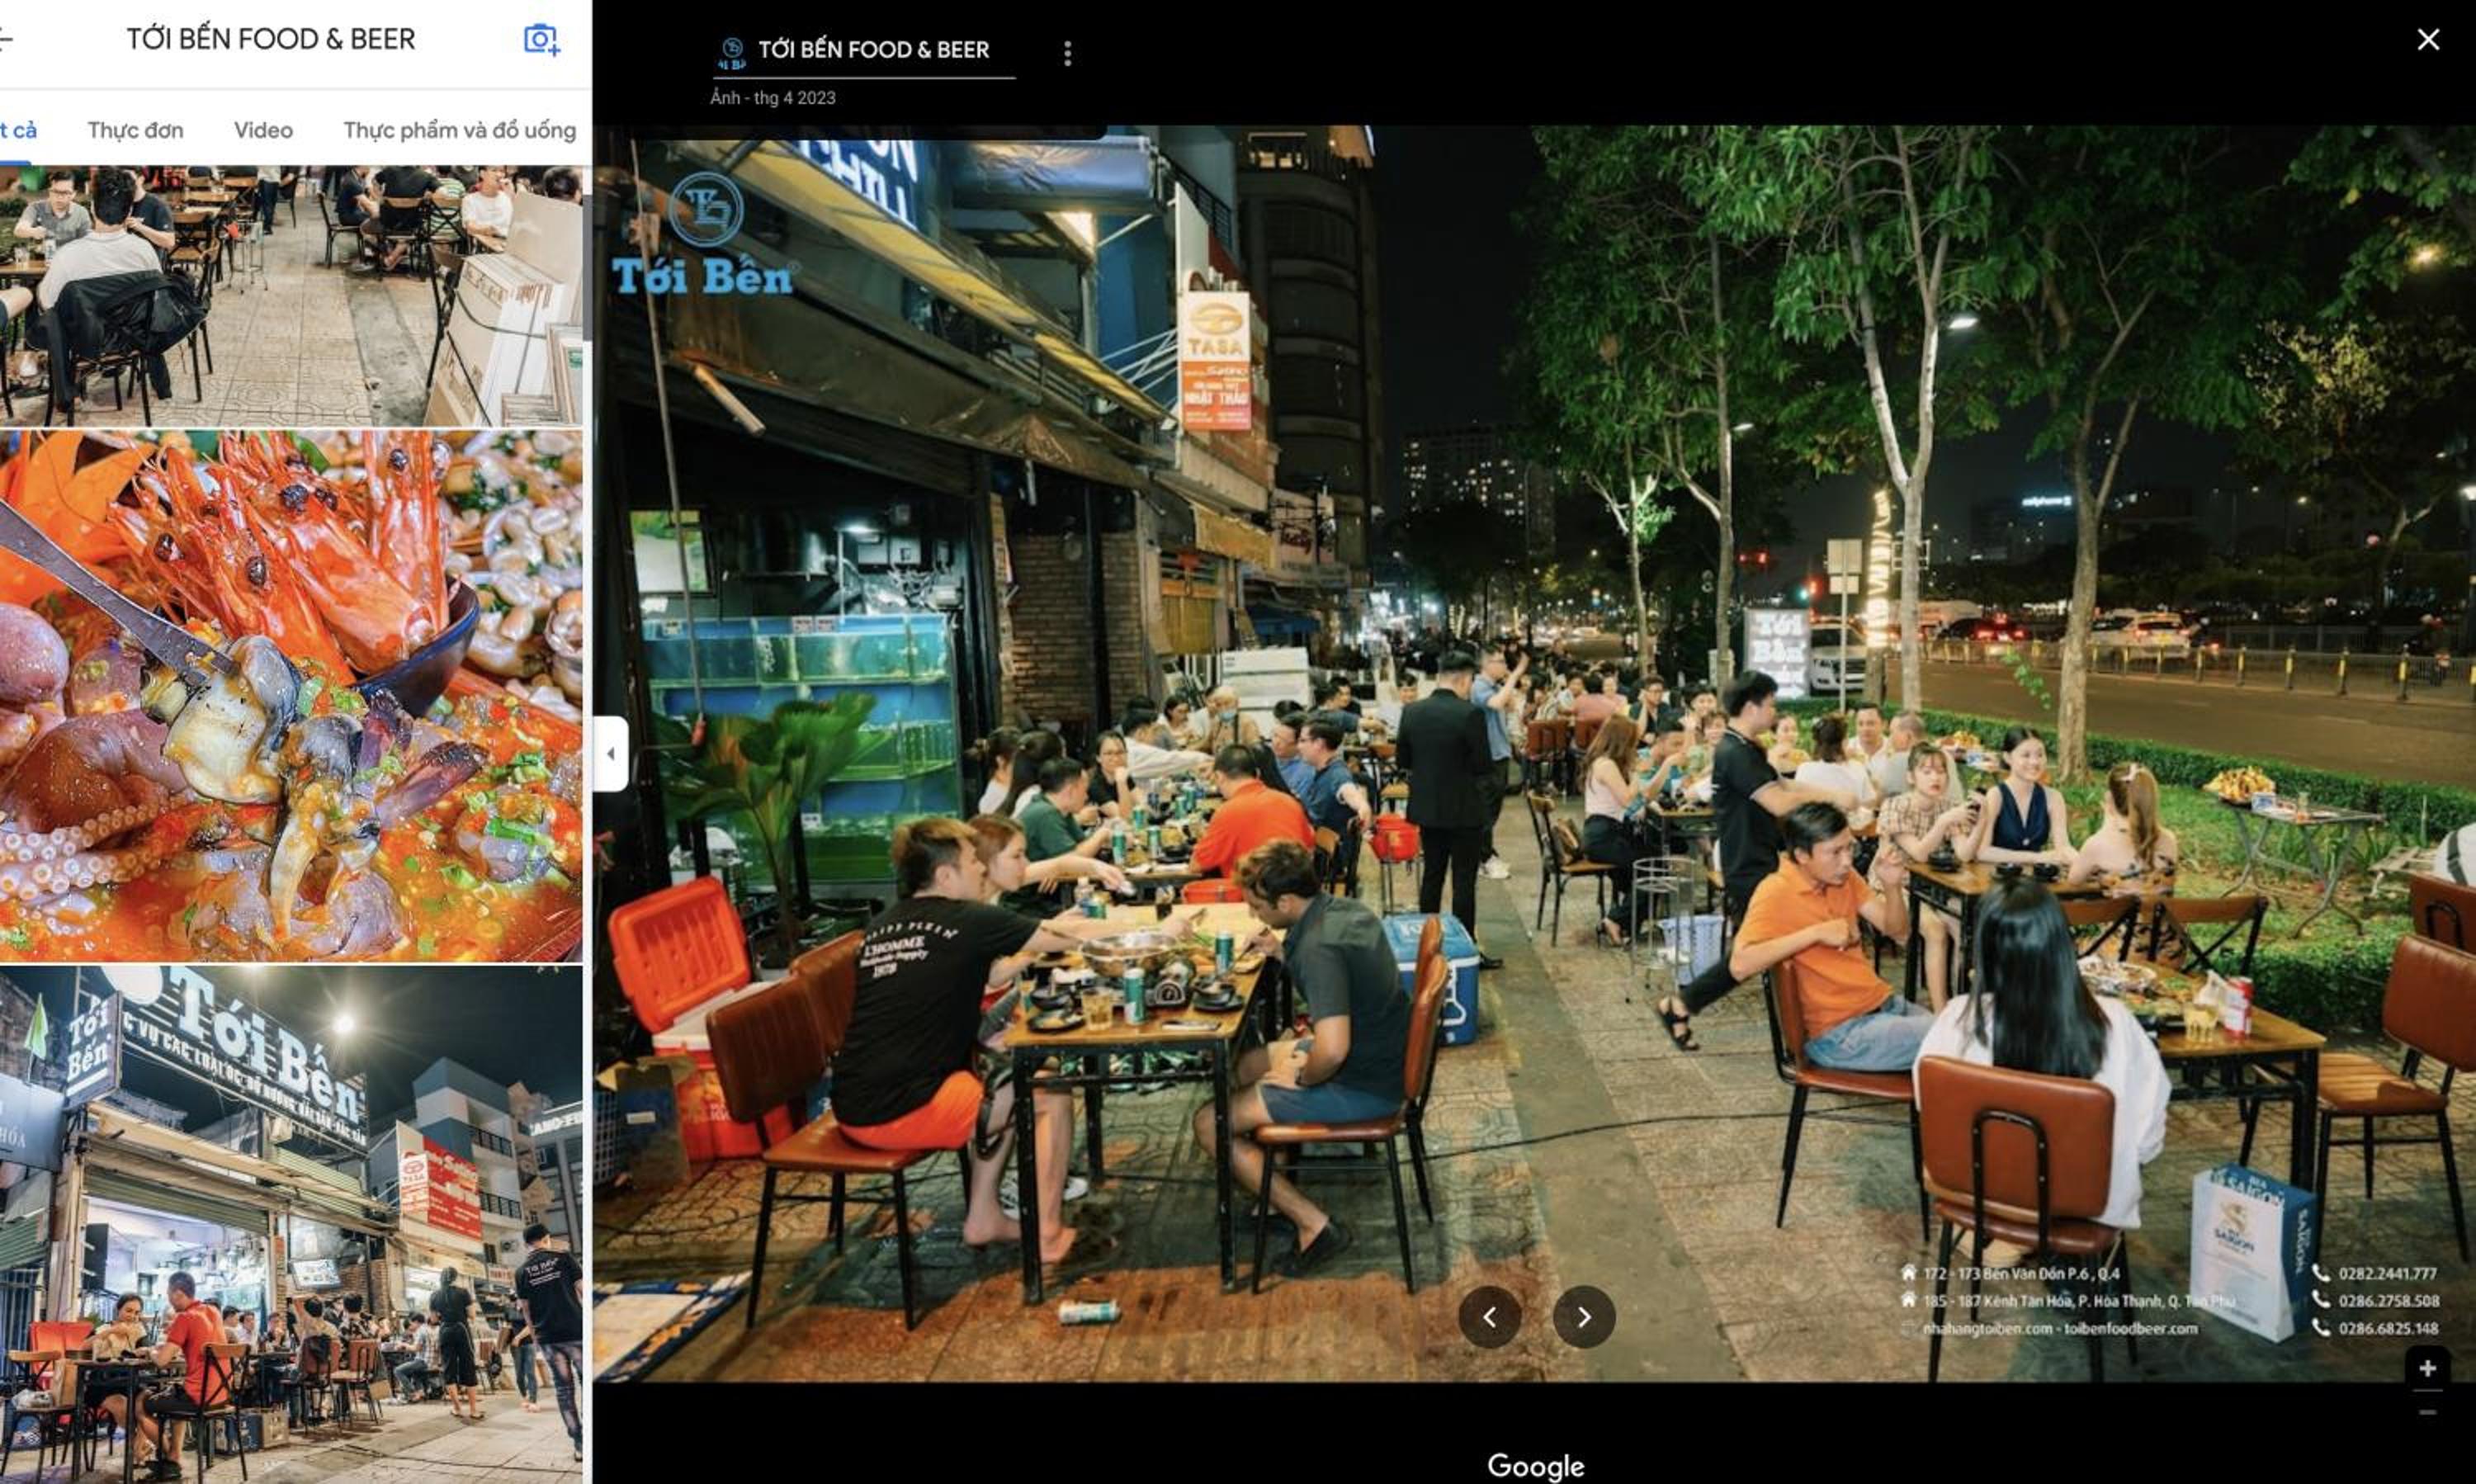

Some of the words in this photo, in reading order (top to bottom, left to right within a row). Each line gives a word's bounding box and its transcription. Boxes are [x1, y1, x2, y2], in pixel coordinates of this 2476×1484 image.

[126, 21, 171, 50] TỚI
[180, 19, 230, 50] BẾN
[239, 26, 319, 50] FOOD
[326, 26, 344, 50] &
[351, 26, 415, 50] BEER
[758, 36, 795, 59] TỚI
[801, 34, 843, 59] BẾN
[848, 40, 913, 59] FOOD
[917, 40, 932, 59] &
[938, 40, 990, 59] BEER
[710, 87, 740, 105] Ảnh
[754, 90, 779, 108] thg
[783, 91, 793, 105] 4
[798, 90, 836, 105] 2023
[12, 120, 37, 139] cả
[87, 121, 139, 144] Thực
[144, 121, 184, 139] đơn
[234, 121, 294, 139] Video
[343, 121, 395, 144] Thực
[400, 118, 458, 144] phẩm
[463, 121, 488, 139] và
[492, 118, 520, 139] đồ
[524, 118, 577, 144] uống
[169, 966, 267, 1075] Tới
[278, 1028, 361, 1125] Bến
[1487, 1452, 1585, 1484] Google
